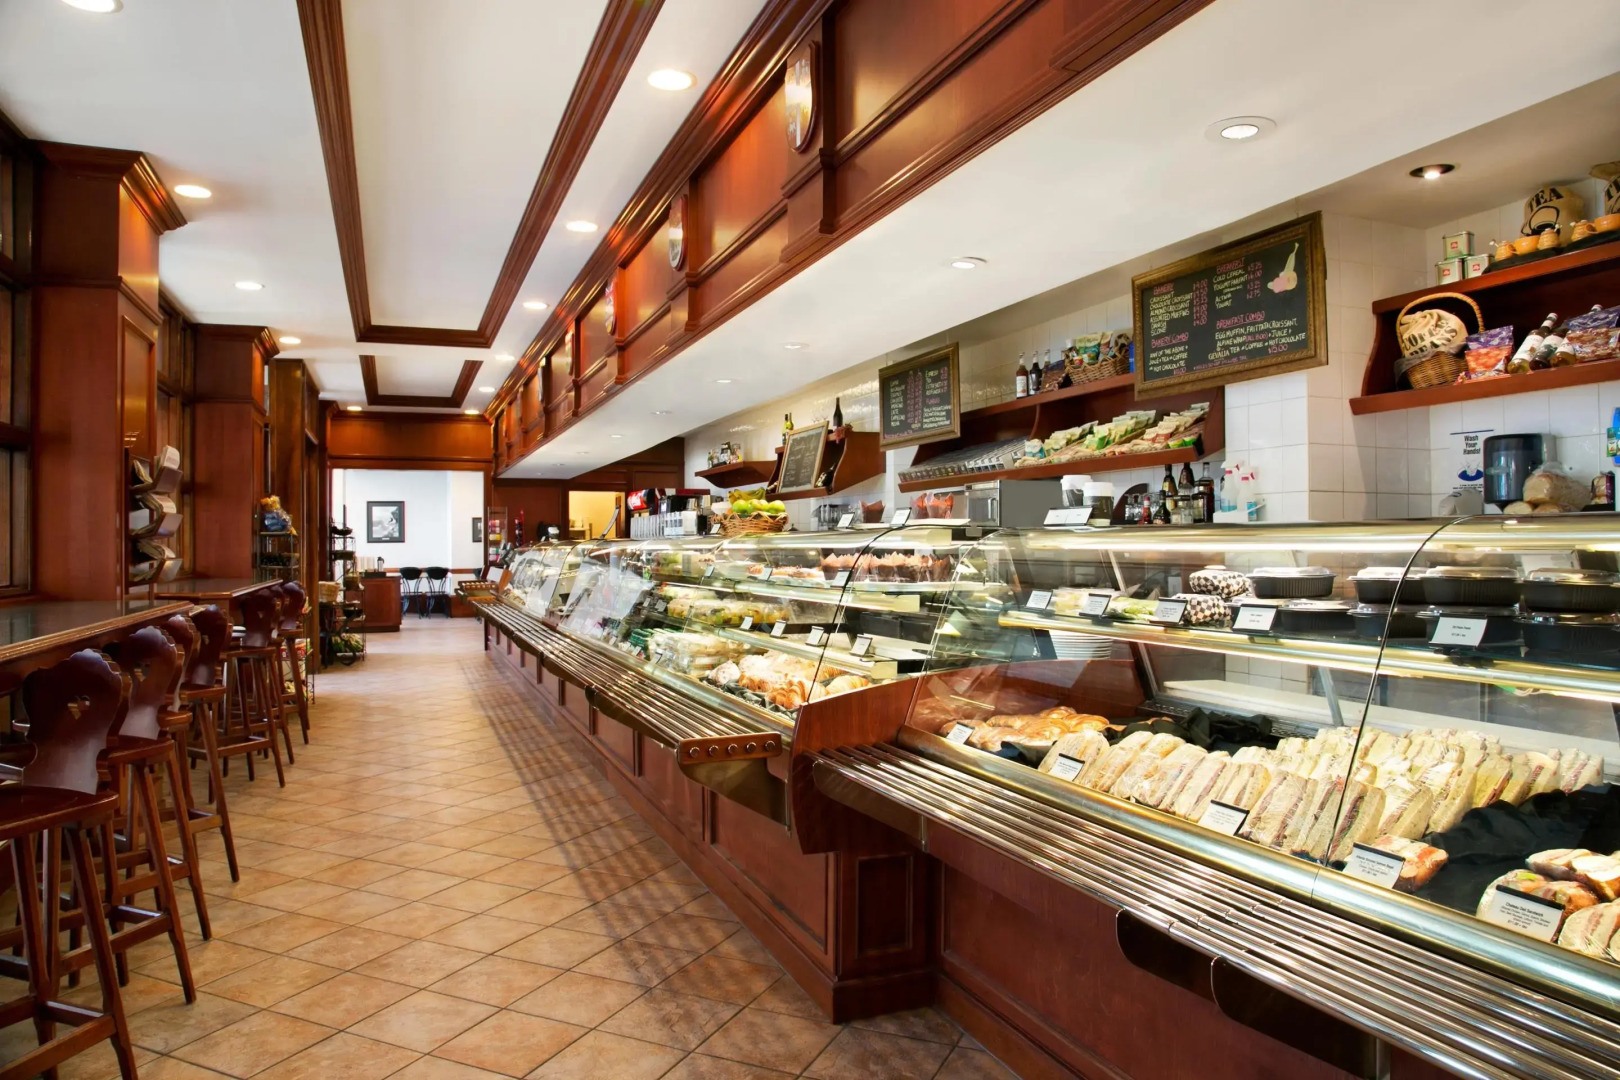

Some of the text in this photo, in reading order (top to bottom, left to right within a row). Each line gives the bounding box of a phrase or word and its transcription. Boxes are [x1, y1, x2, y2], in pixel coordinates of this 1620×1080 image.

[1529, 187, 1564, 213] TEA
[1246, 312, 1266, 323] COMBO
[1216, 332, 1225, 340] EGG
